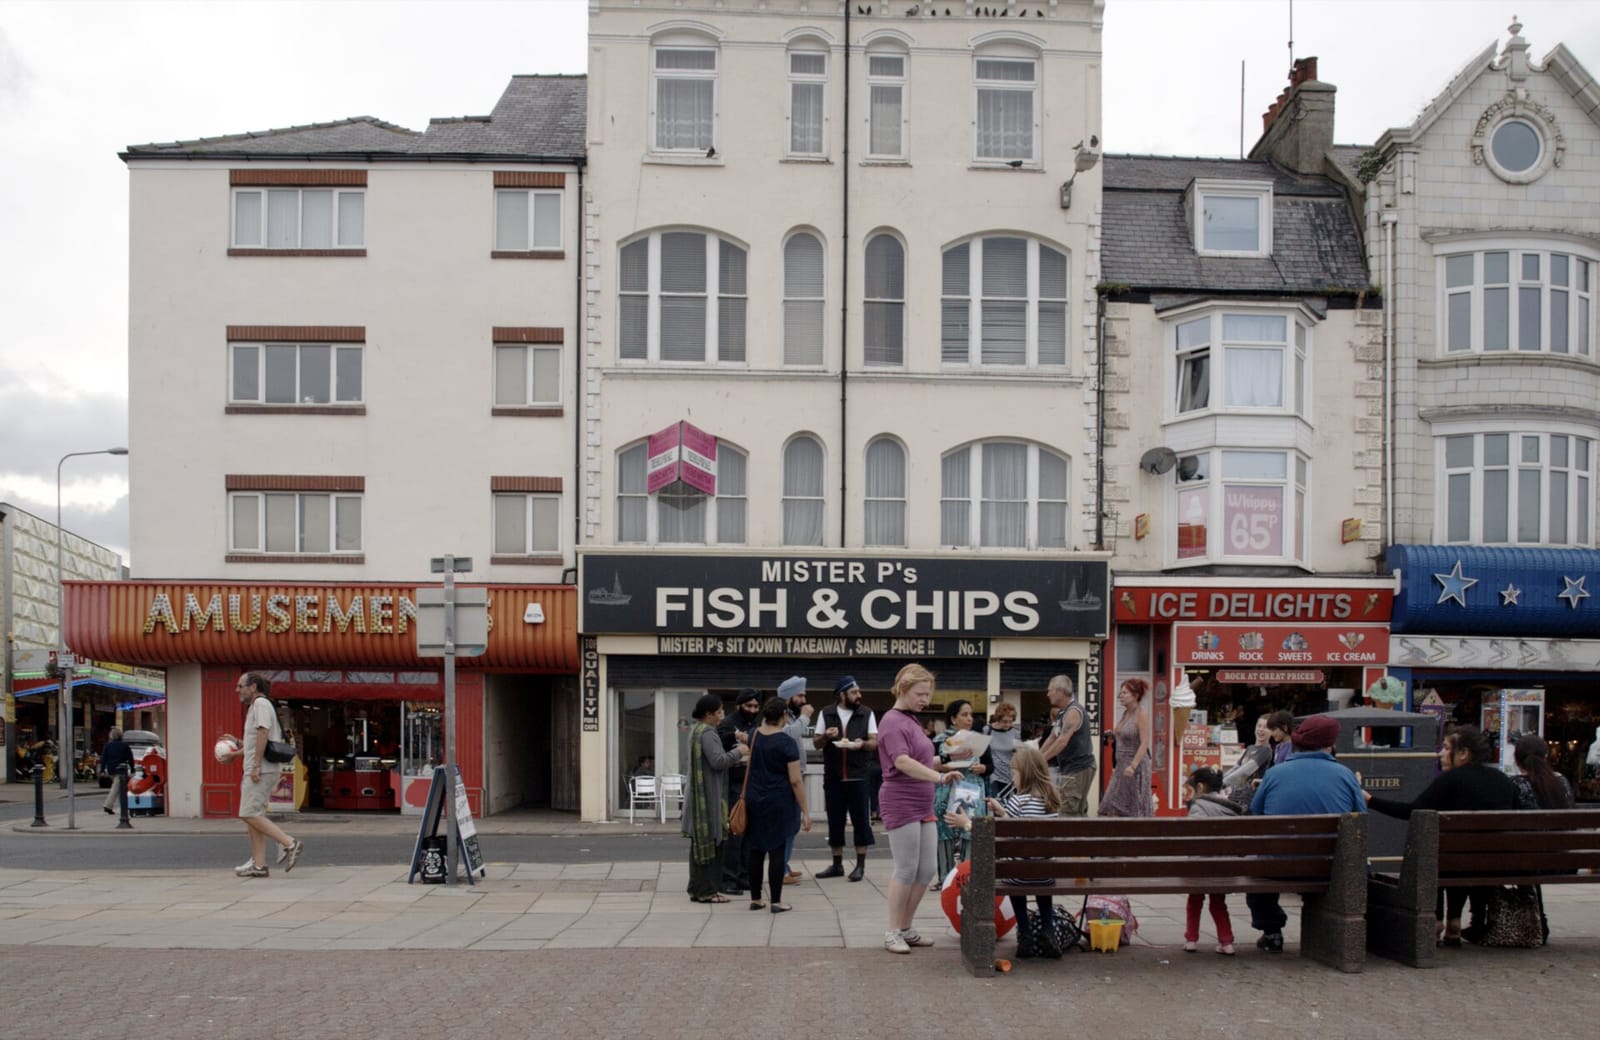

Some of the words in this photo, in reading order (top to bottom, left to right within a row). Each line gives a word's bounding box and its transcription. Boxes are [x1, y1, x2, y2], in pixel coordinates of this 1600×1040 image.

[1227, 494, 1276, 512] Whippy
[762, 561, 866, 583] MISTER
[878, 562, 918, 584] P's
[656, 587, 787, 629] FISH
[806, 588, 849, 629] &
[860, 589, 1040, 632] CHIPS
[1150, 592, 1197, 618] ICE
[1208, 593, 1352, 618] DELIGHTS
[661, 637, 703, 653] MISTER
[706, 637, 724, 653] P's
[726, 637, 745, 653] SIT
[749, 637, 782, 654] DOWN
[855, 639, 887, 655] SAME
[890, 640, 924, 656] PRICE
[958, 640, 984, 656] No.1
[1191, 652, 1224, 661] DRINKS
[1239, 652, 1263, 661] ROCK
[1278, 652, 1312, 661] SWEETS
[1327, 652, 1341, 661] ICE
[1343, 652, 1376, 662] CREAM
[585, 651, 598, 715] QUALITY
[1224, 672, 1245, 680] ROCK
[1248, 672, 1258, 680] AT
[1259, 672, 1285, 680] GREAT
[1287, 672, 1315, 680] PRICES
[1086, 657, 1099, 720] QUALITY
[1184, 735, 1205, 746] 65p
[1365, 777, 1400, 788] LITTER
